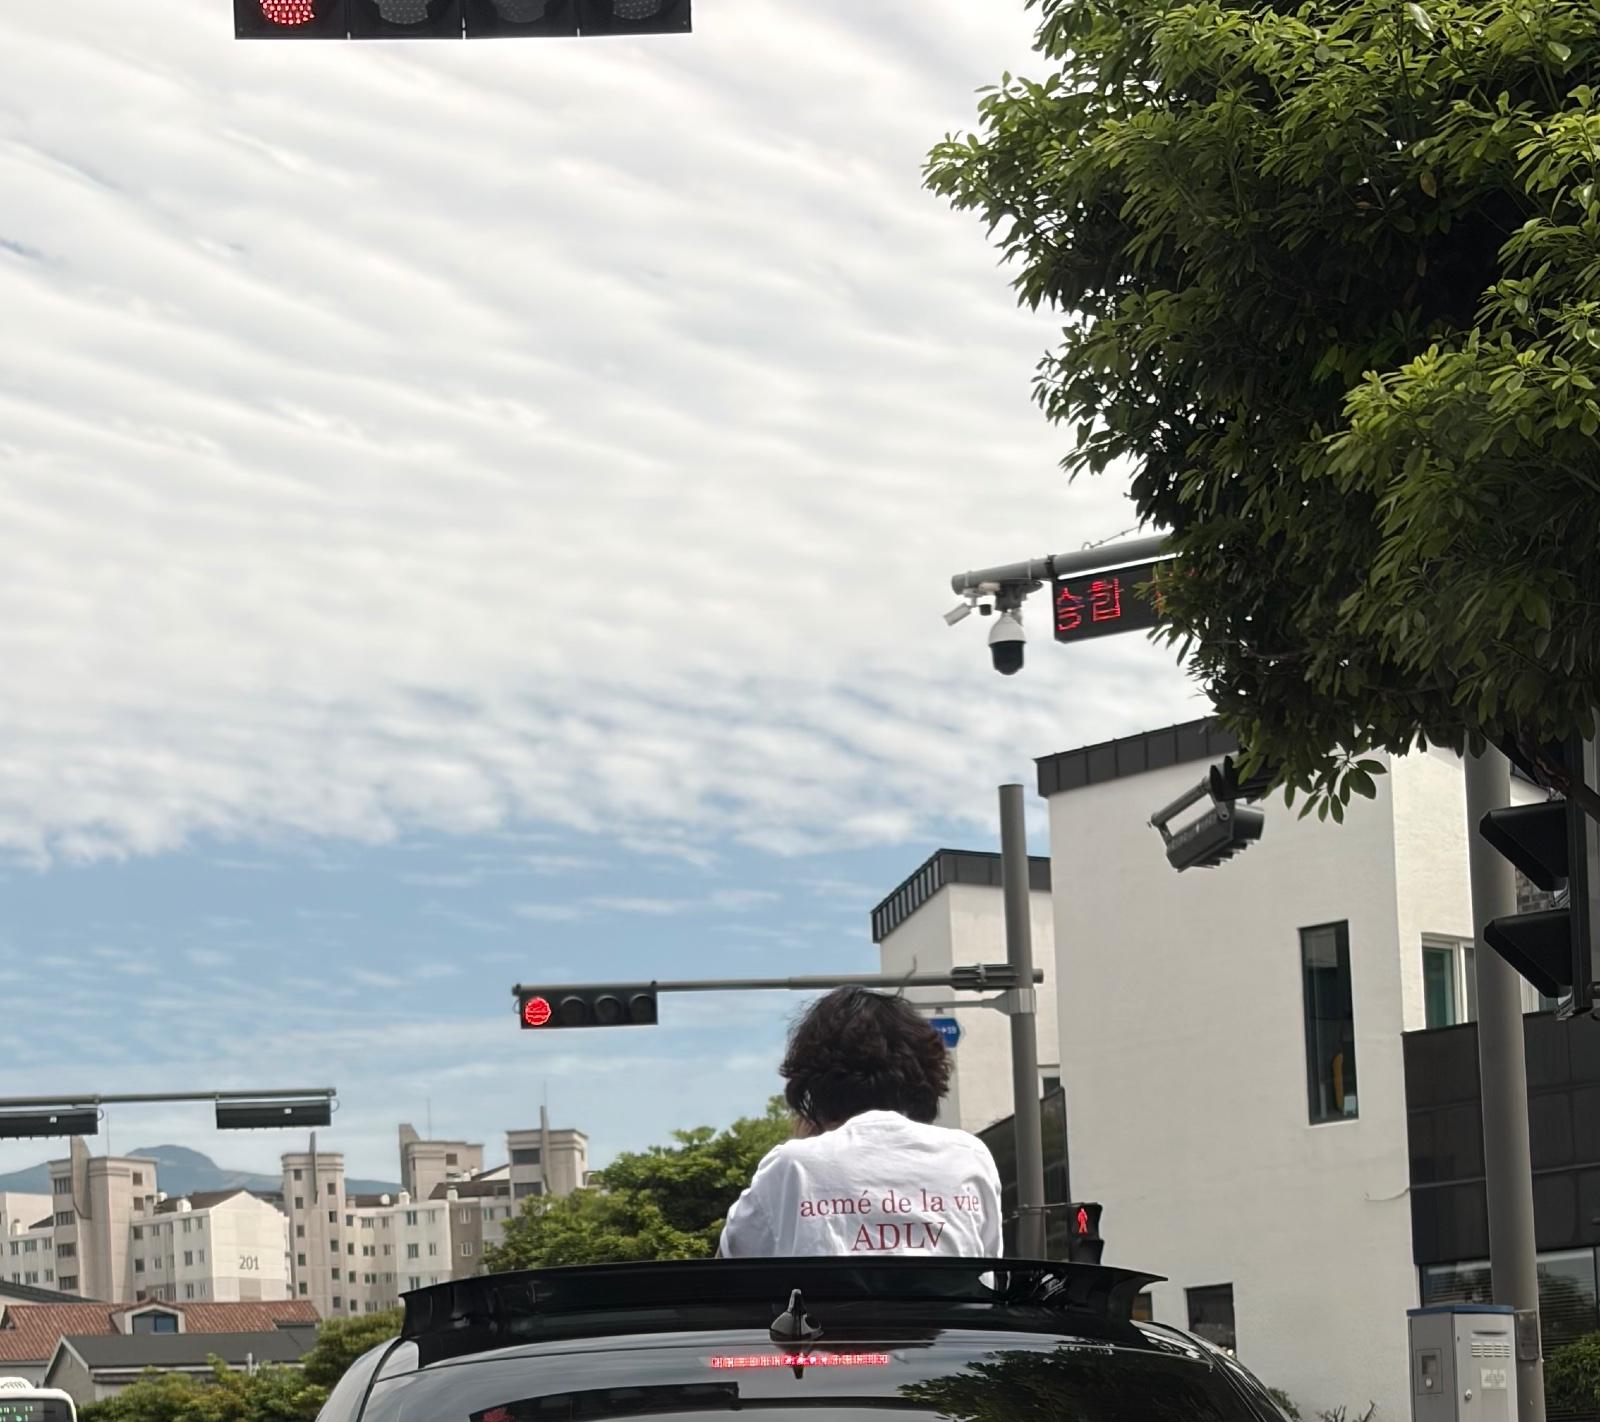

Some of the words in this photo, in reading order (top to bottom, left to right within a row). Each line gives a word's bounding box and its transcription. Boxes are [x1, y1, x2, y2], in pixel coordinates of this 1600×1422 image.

[800, 1190, 871, 1217] acmé
[882, 1190, 911, 1213] de
[920, 1188, 945, 1212] la
[954, 1186, 979, 1211] vie
[851, 1222, 945, 1250] ADLV
[239, 1255, 259, 1270] 201
